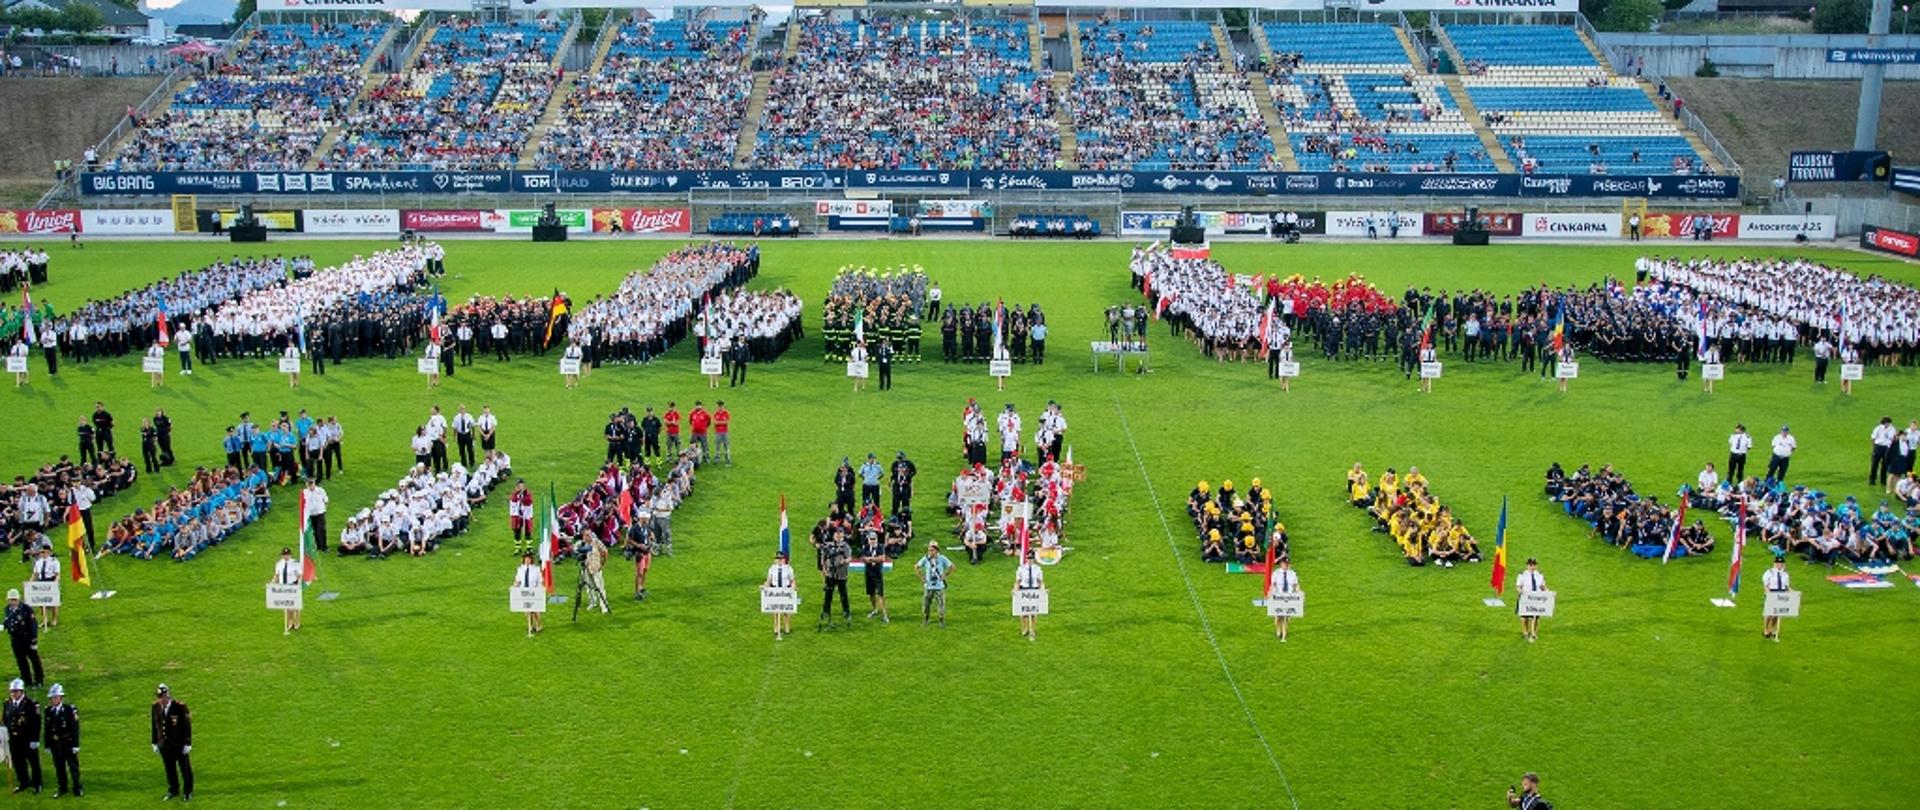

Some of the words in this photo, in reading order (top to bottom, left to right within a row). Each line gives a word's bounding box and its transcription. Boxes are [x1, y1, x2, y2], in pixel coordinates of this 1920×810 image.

[93, 176, 116, 190] BIG
[117, 175, 155, 190] BANG
[631, 209, 682, 233] Union
[1550, 222, 1608, 232] CINKARNA
